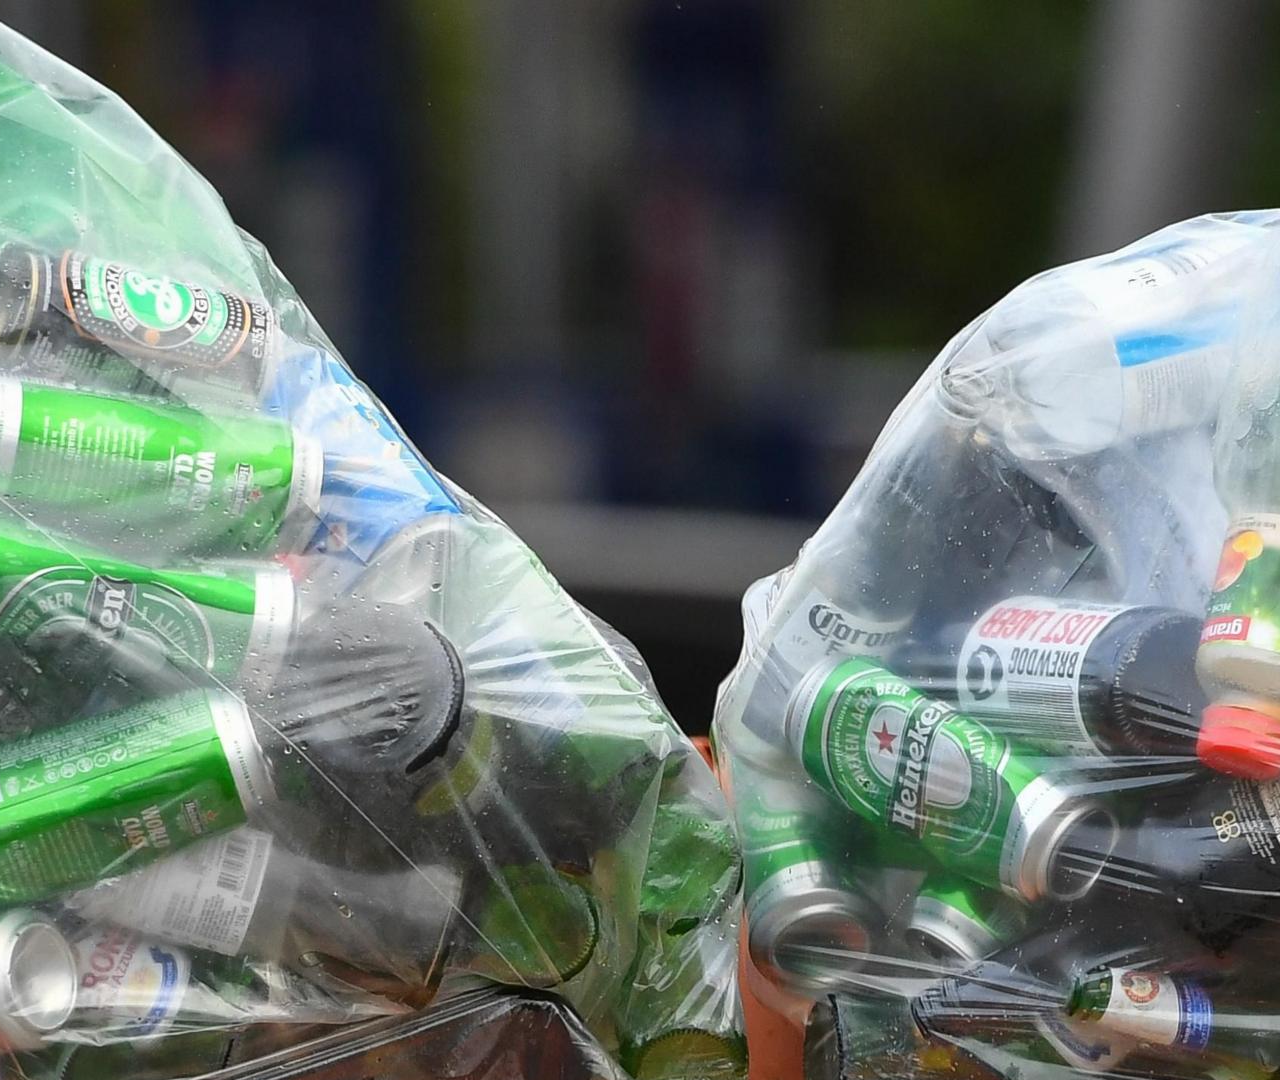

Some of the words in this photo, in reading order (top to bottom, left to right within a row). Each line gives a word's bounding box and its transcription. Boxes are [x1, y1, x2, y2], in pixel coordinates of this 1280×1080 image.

[104, 262, 138, 333] BROOKL
[37, 592, 74, 614] BEER
[808, 603, 898, 648] Coron
[1039, 612, 1109, 646] LOST
[1007, 646, 1081, 679] BREWDOG
[875, 682, 910, 697] BEER
[891, 699, 957, 830] Heineken
